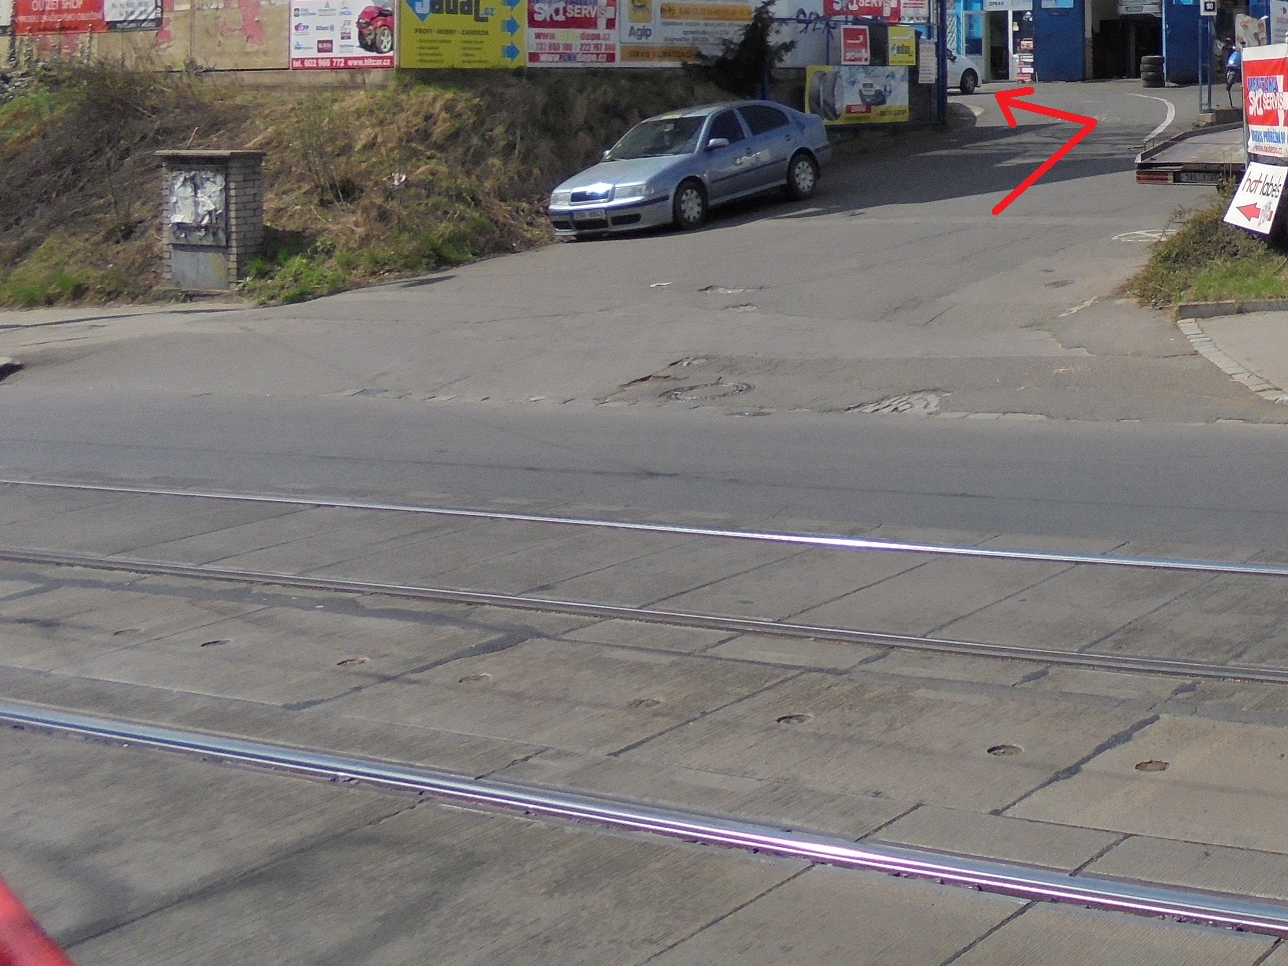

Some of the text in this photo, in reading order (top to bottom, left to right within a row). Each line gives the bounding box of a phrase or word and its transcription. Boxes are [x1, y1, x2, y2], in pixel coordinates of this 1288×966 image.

[566, 5, 605, 17] SERVIS
[628, 25, 652, 40] Agip
[1263, 93, 1283, 110] SERVIS
[1242, 171, 1282, 198] hot labels
